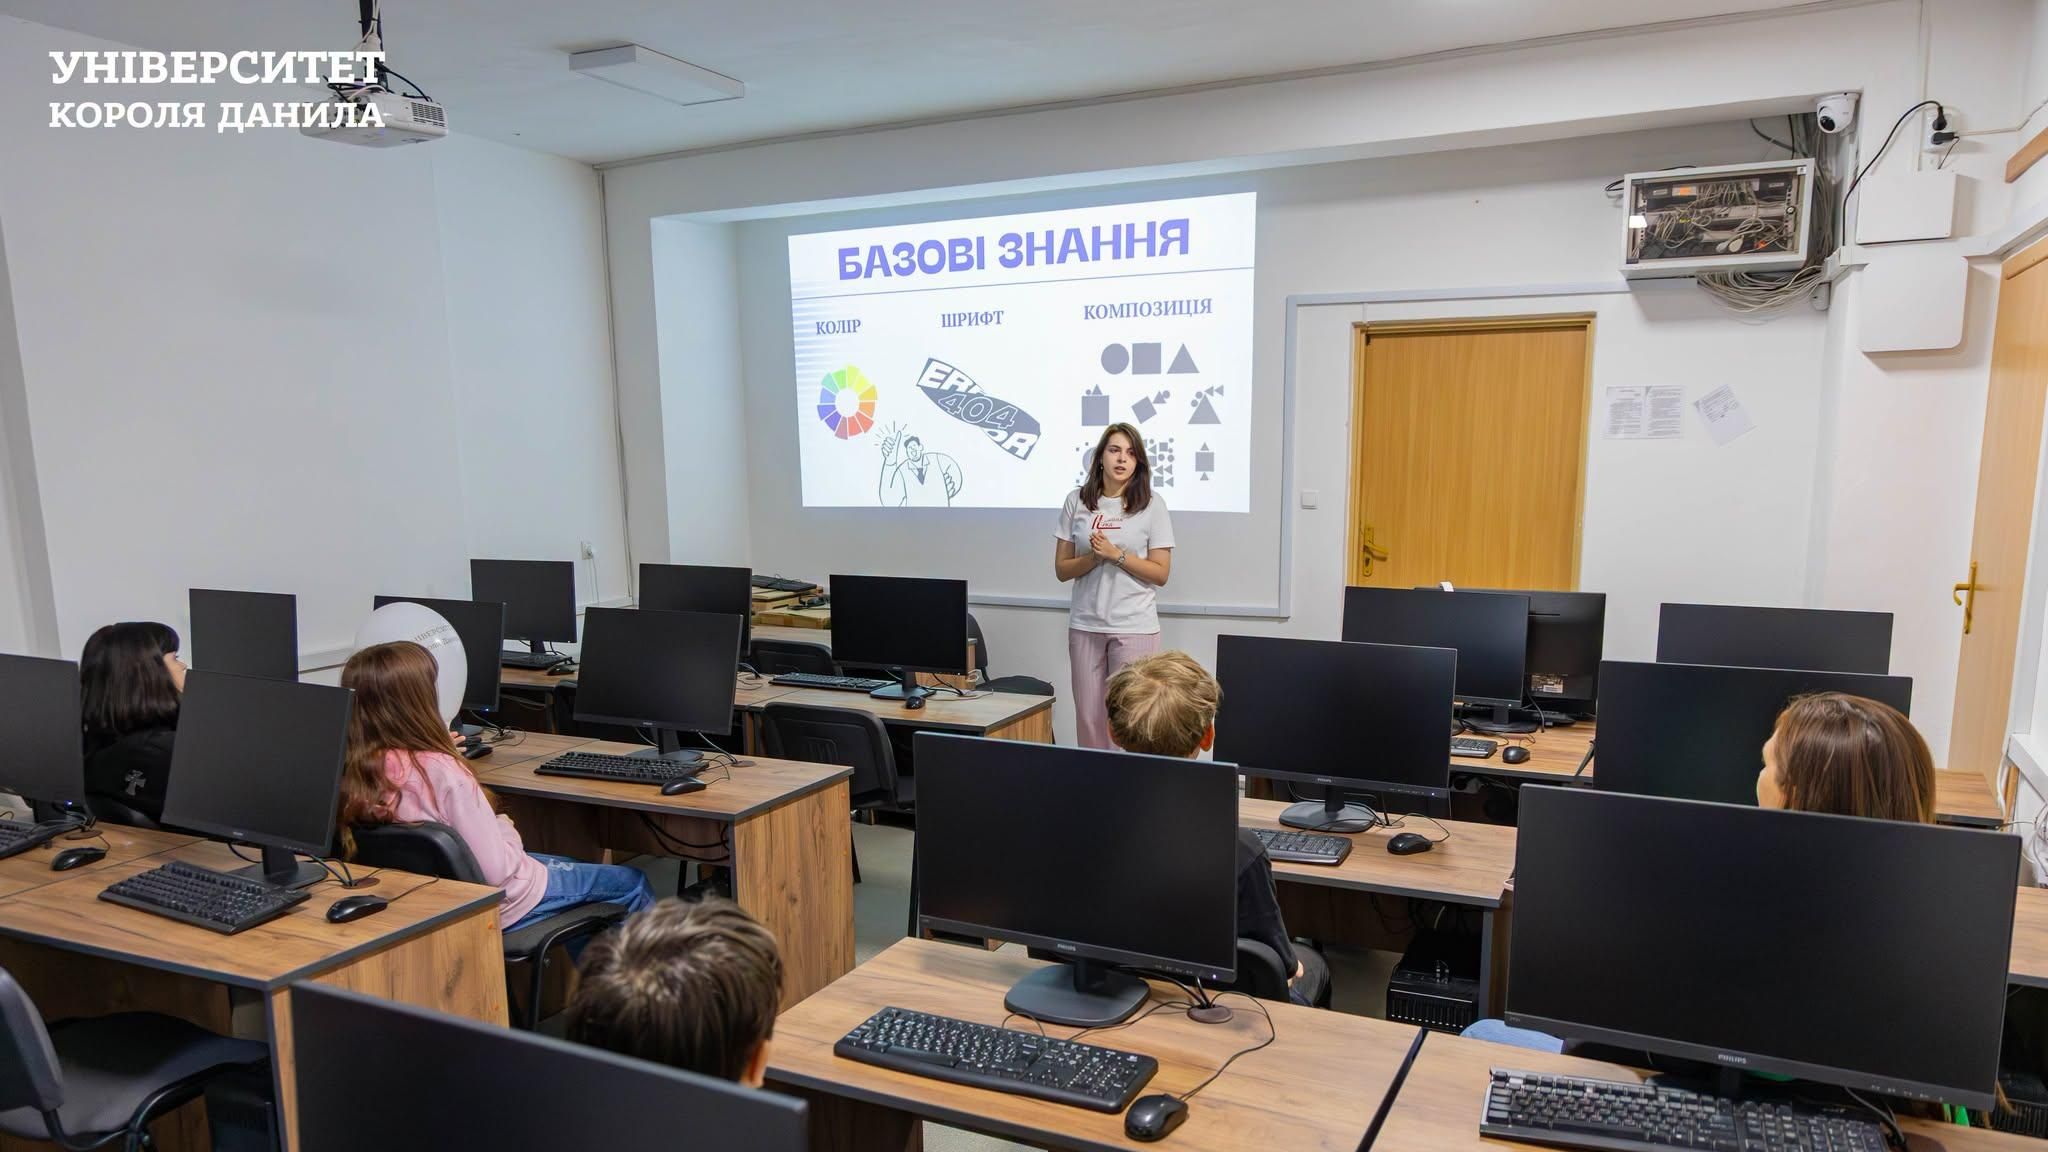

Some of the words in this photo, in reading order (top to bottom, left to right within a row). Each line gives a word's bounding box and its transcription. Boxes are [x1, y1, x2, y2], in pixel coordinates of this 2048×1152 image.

[838, 236, 985, 280] БАЗОВІ
[998, 218, 1190, 268] ЗНАННЯ
[941, 310, 1004, 328] ШРИФТ
[1083, 298, 1212, 320] КОМПОЗИЦІЯ
[816, 319, 862, 335] КОЛІР
[938, 393, 1018, 429] 404
